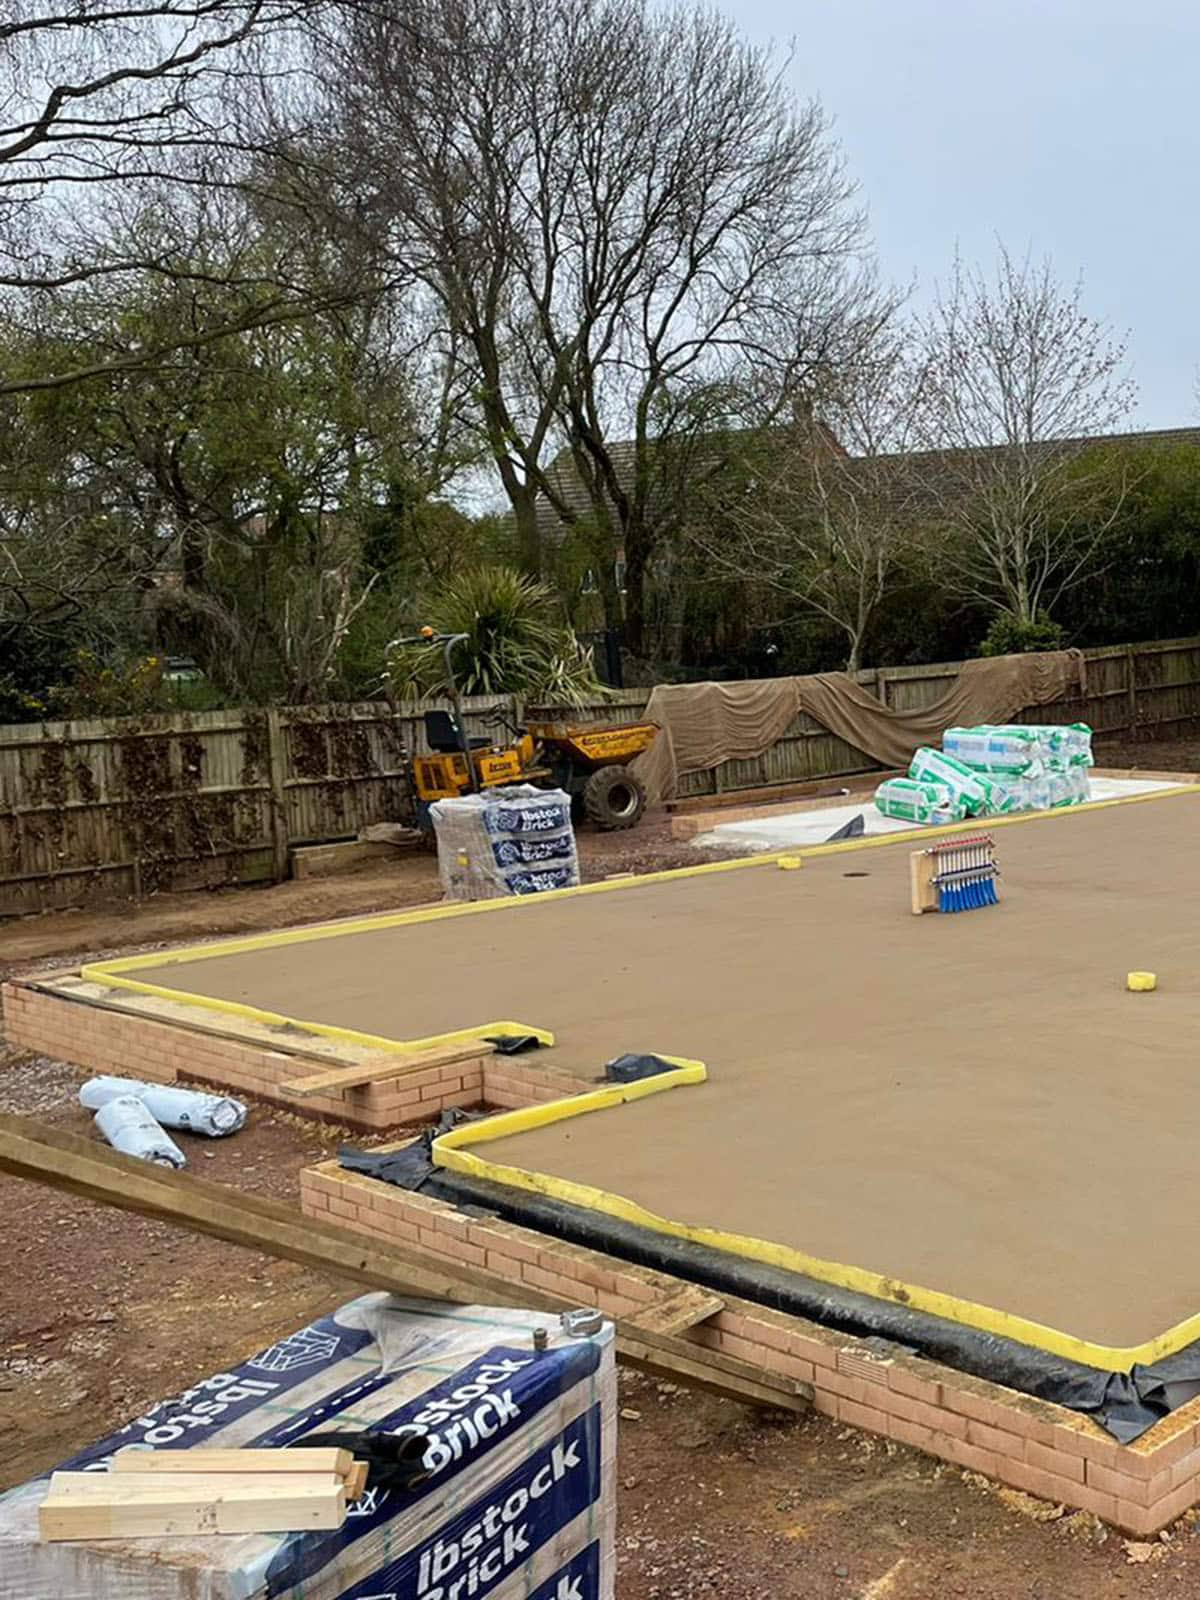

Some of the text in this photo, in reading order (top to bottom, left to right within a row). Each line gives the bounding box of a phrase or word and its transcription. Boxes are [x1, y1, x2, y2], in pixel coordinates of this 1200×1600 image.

[384, 1358, 533, 1437] stock
[422, 1388, 521, 1478] Brick
[417, 1439, 581, 1596] Ibstock
